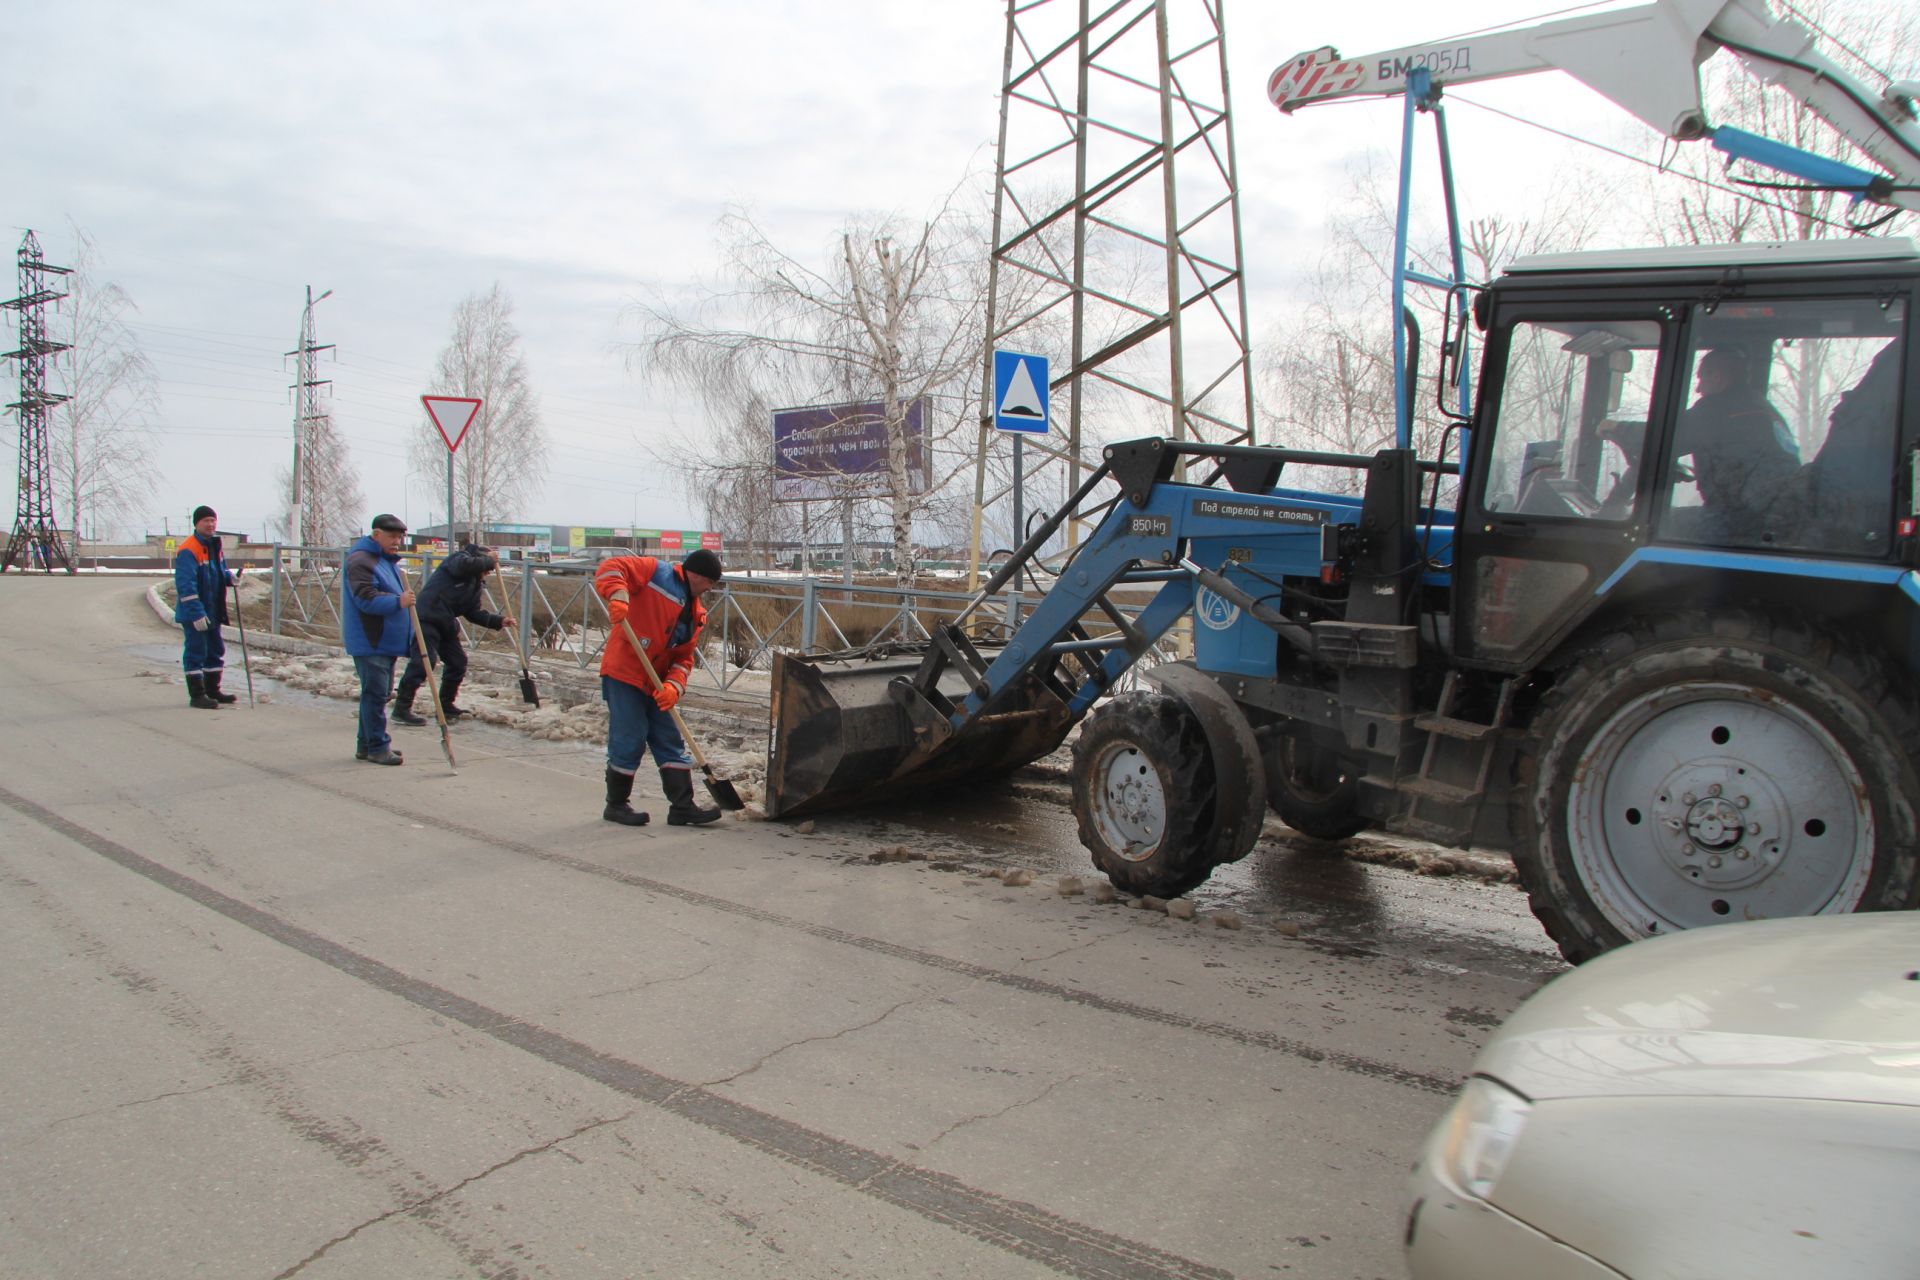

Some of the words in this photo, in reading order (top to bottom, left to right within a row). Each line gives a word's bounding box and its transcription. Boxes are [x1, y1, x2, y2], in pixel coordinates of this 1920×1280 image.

[1201, 501, 1218, 513] Под
[1221, 505, 1259, 517] стрелой
[1263, 509, 1275, 518] не
[1278, 510, 1314, 522] стоять
[1132, 518, 1152, 532] 850
[1152, 519, 1166, 535] kg
